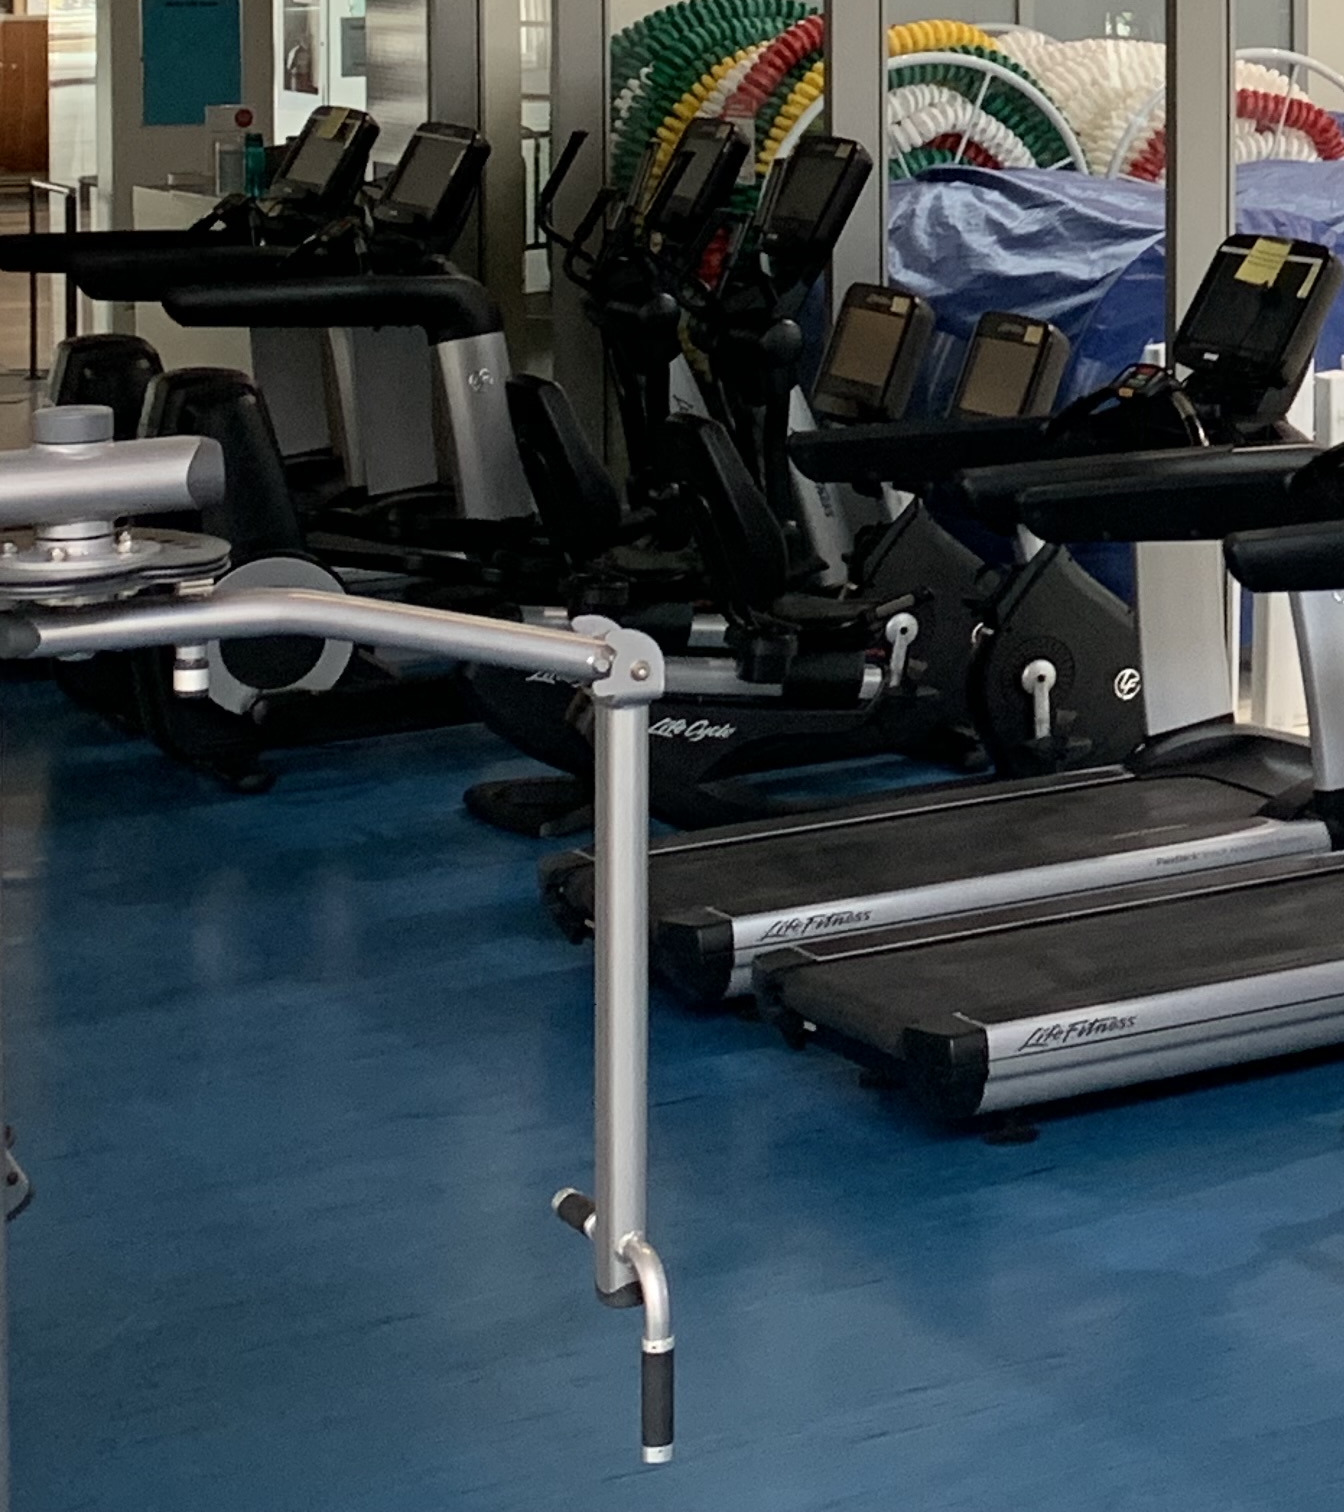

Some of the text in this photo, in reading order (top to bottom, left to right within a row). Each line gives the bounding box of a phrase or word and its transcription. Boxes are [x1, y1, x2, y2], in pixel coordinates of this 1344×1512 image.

[649, 718, 736, 741] Life Cycle
[761, 910, 873, 941] Life Fitness
[1017, 1016, 1137, 1053] Life Fitness
